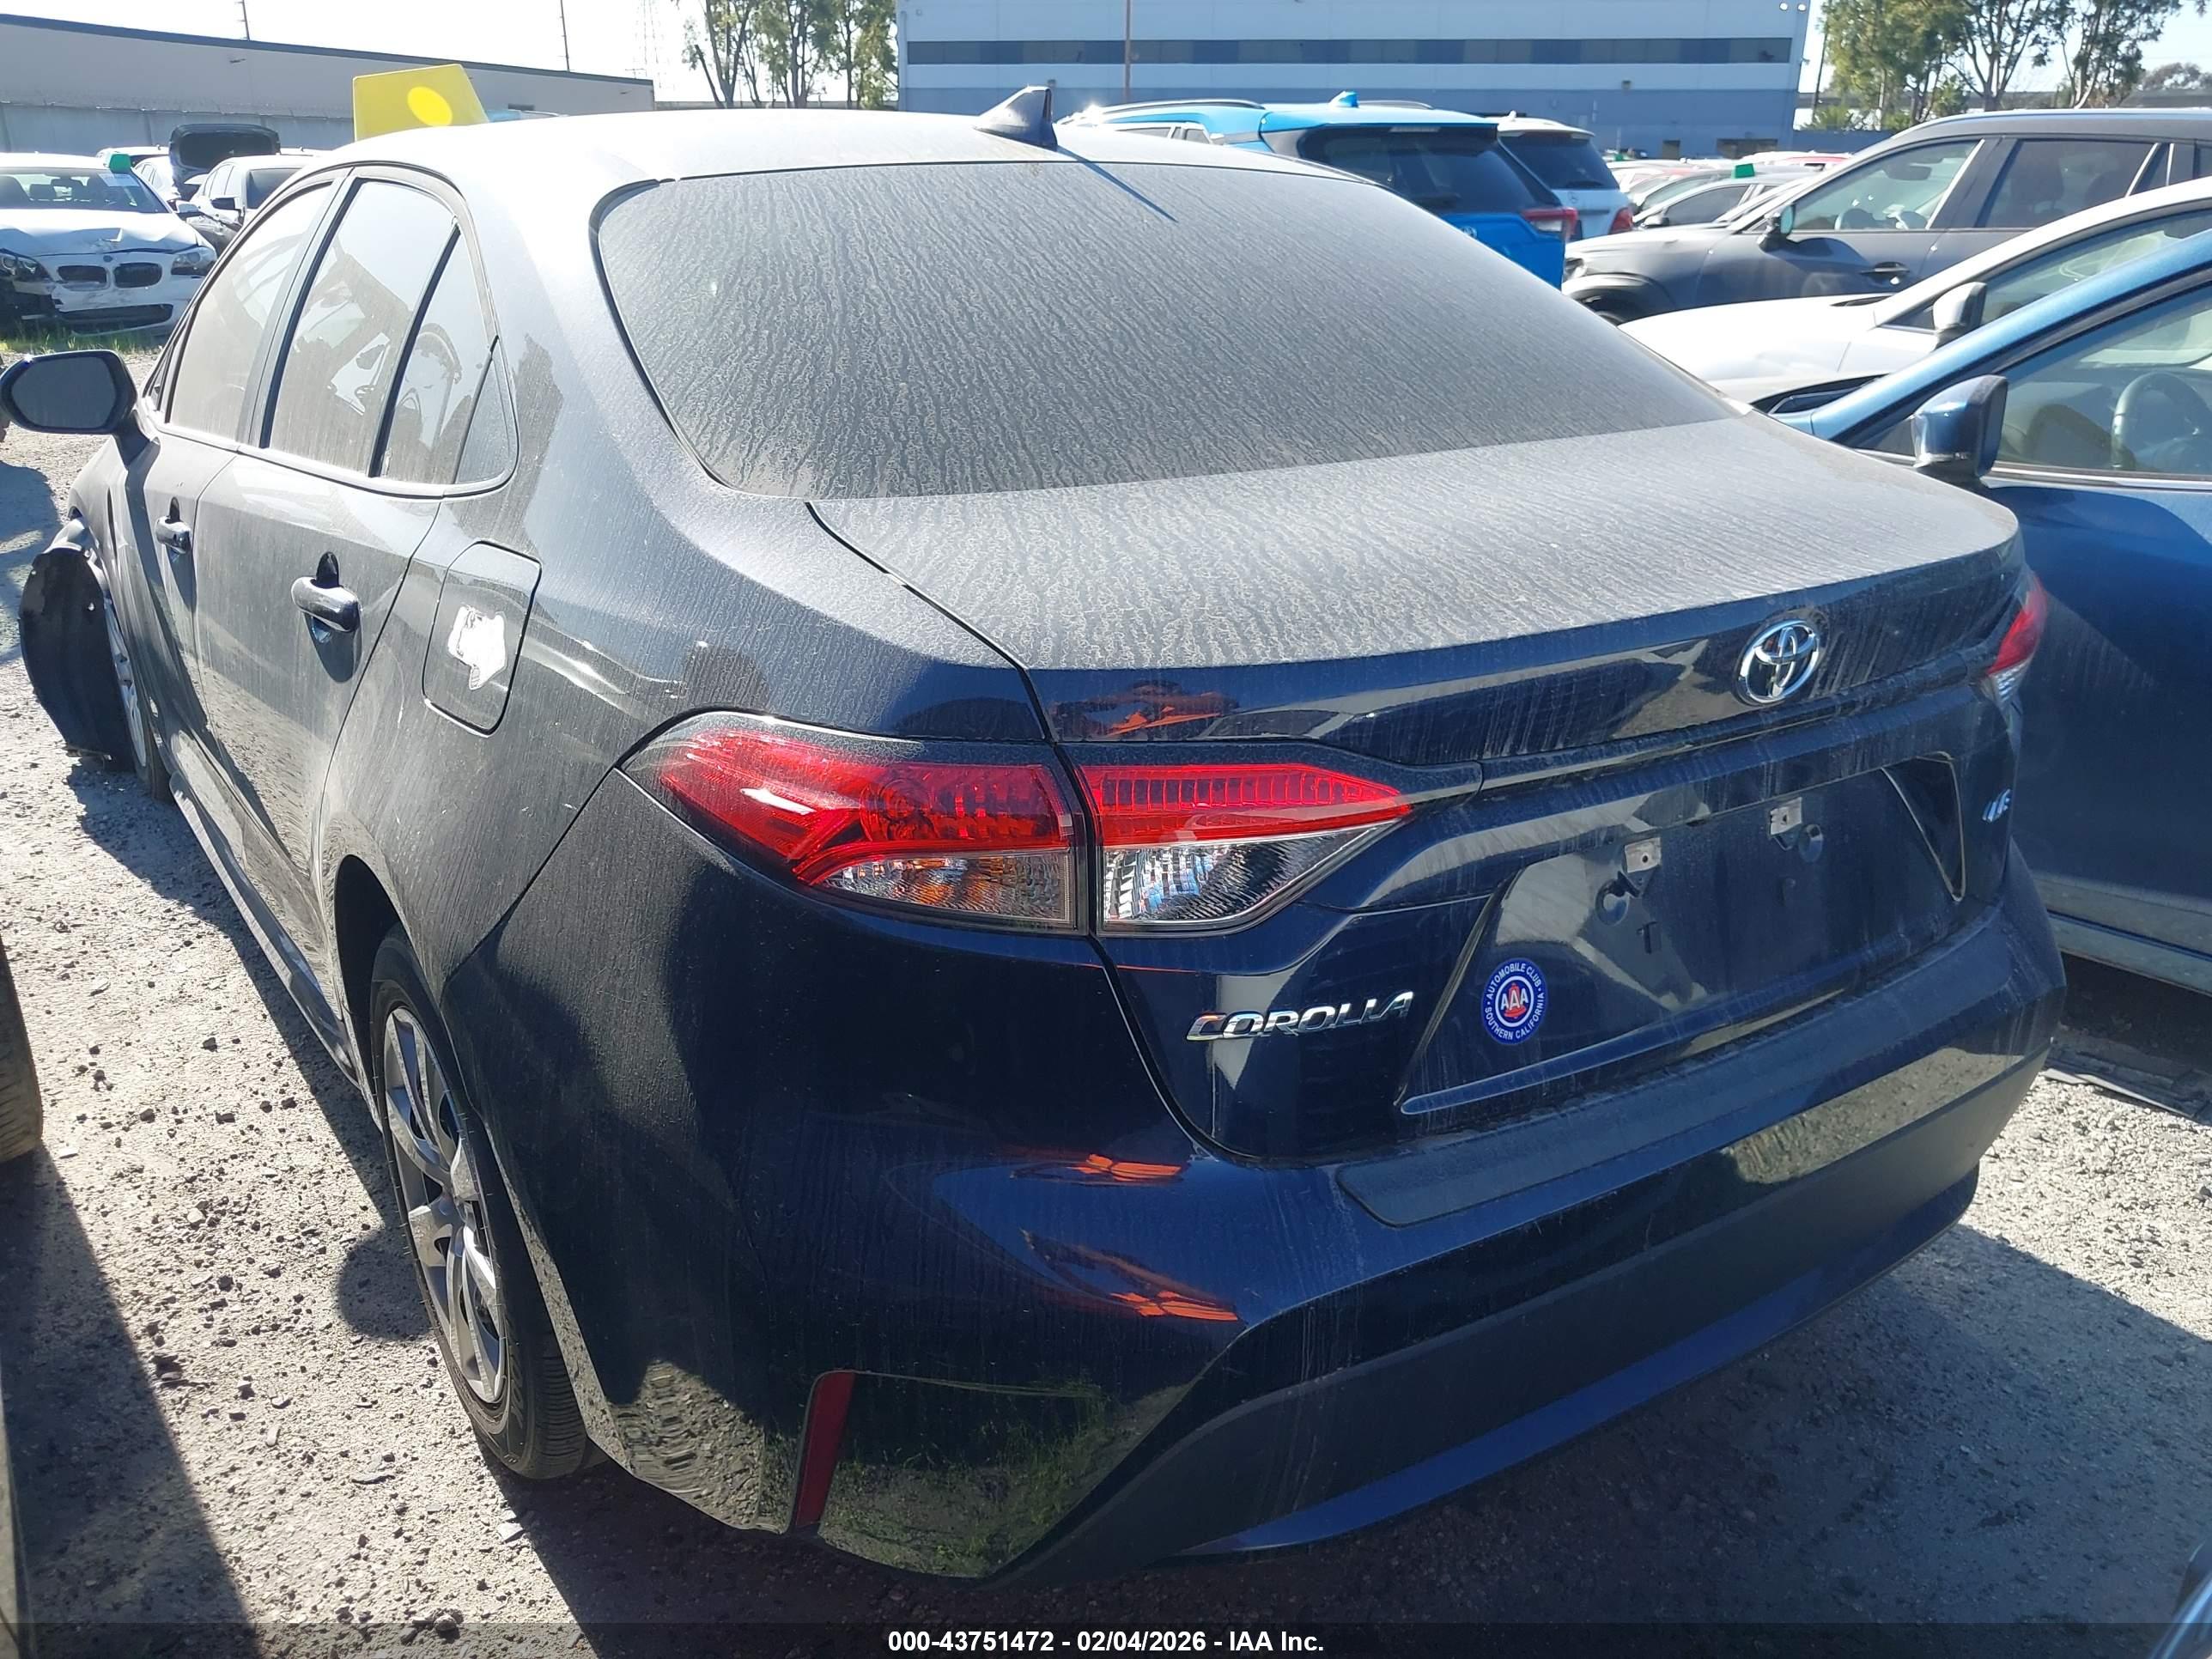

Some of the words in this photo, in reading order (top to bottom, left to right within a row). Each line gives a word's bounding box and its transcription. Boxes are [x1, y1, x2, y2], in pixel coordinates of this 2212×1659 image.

[1486, 962, 1526, 1000] AUTOMOBILE
[1526, 966, 1542, 988] CLUB
[1500, 988, 1528, 1011] AAA
[1186, 990, 1413, 1041] COROLLA
[1485, 1006, 1513, 1041] SOUTHERN
[1515, 992, 1545, 1039] CALIFORNIA
